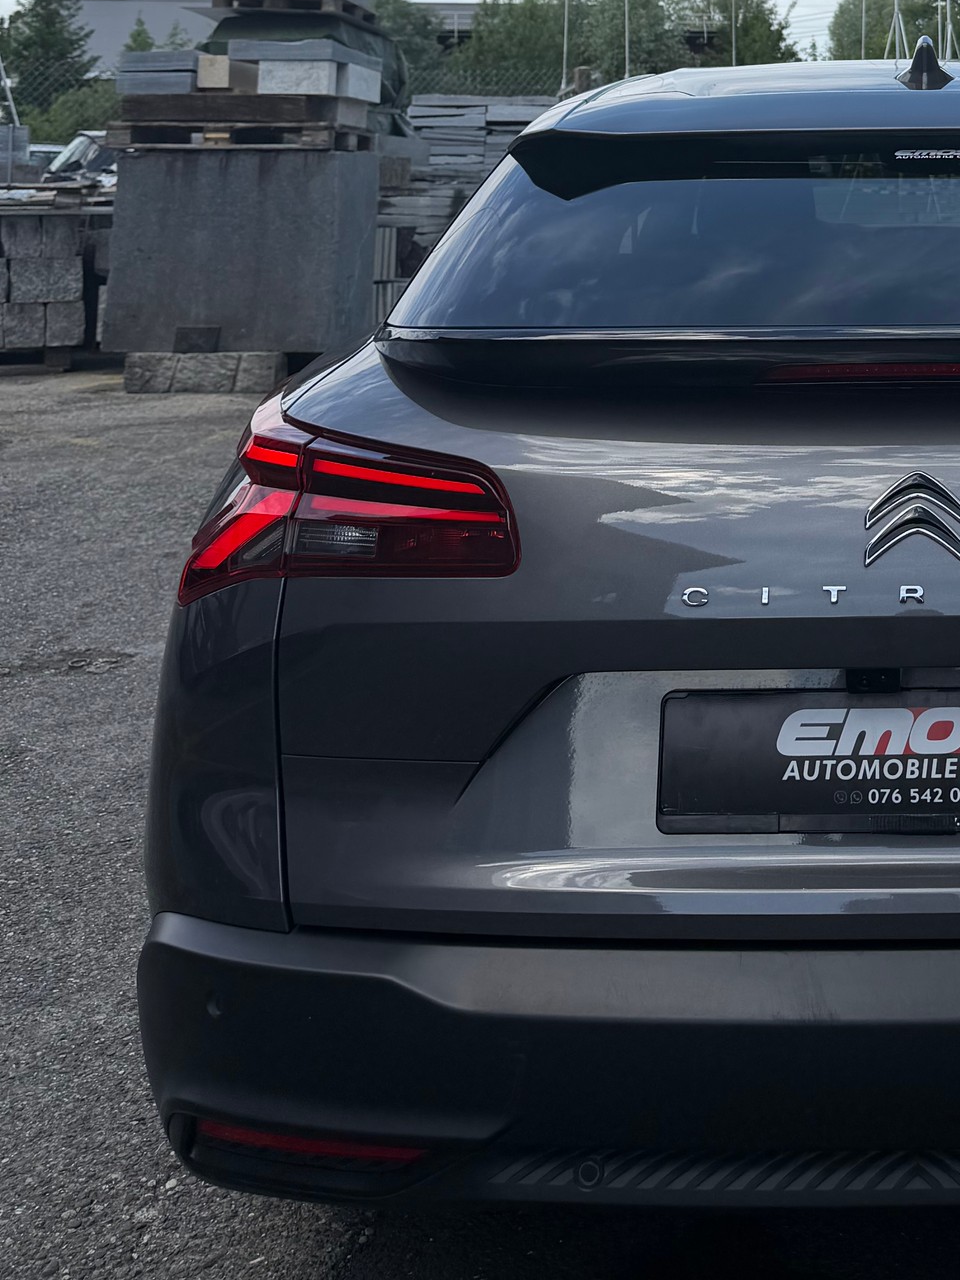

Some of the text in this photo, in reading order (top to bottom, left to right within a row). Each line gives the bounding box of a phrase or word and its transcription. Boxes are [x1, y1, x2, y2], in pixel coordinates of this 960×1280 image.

[782, 758, 958, 781] AUTOMOBILE
[867, 788, 902, 804] 076
[909, 787, 943, 803] 542
